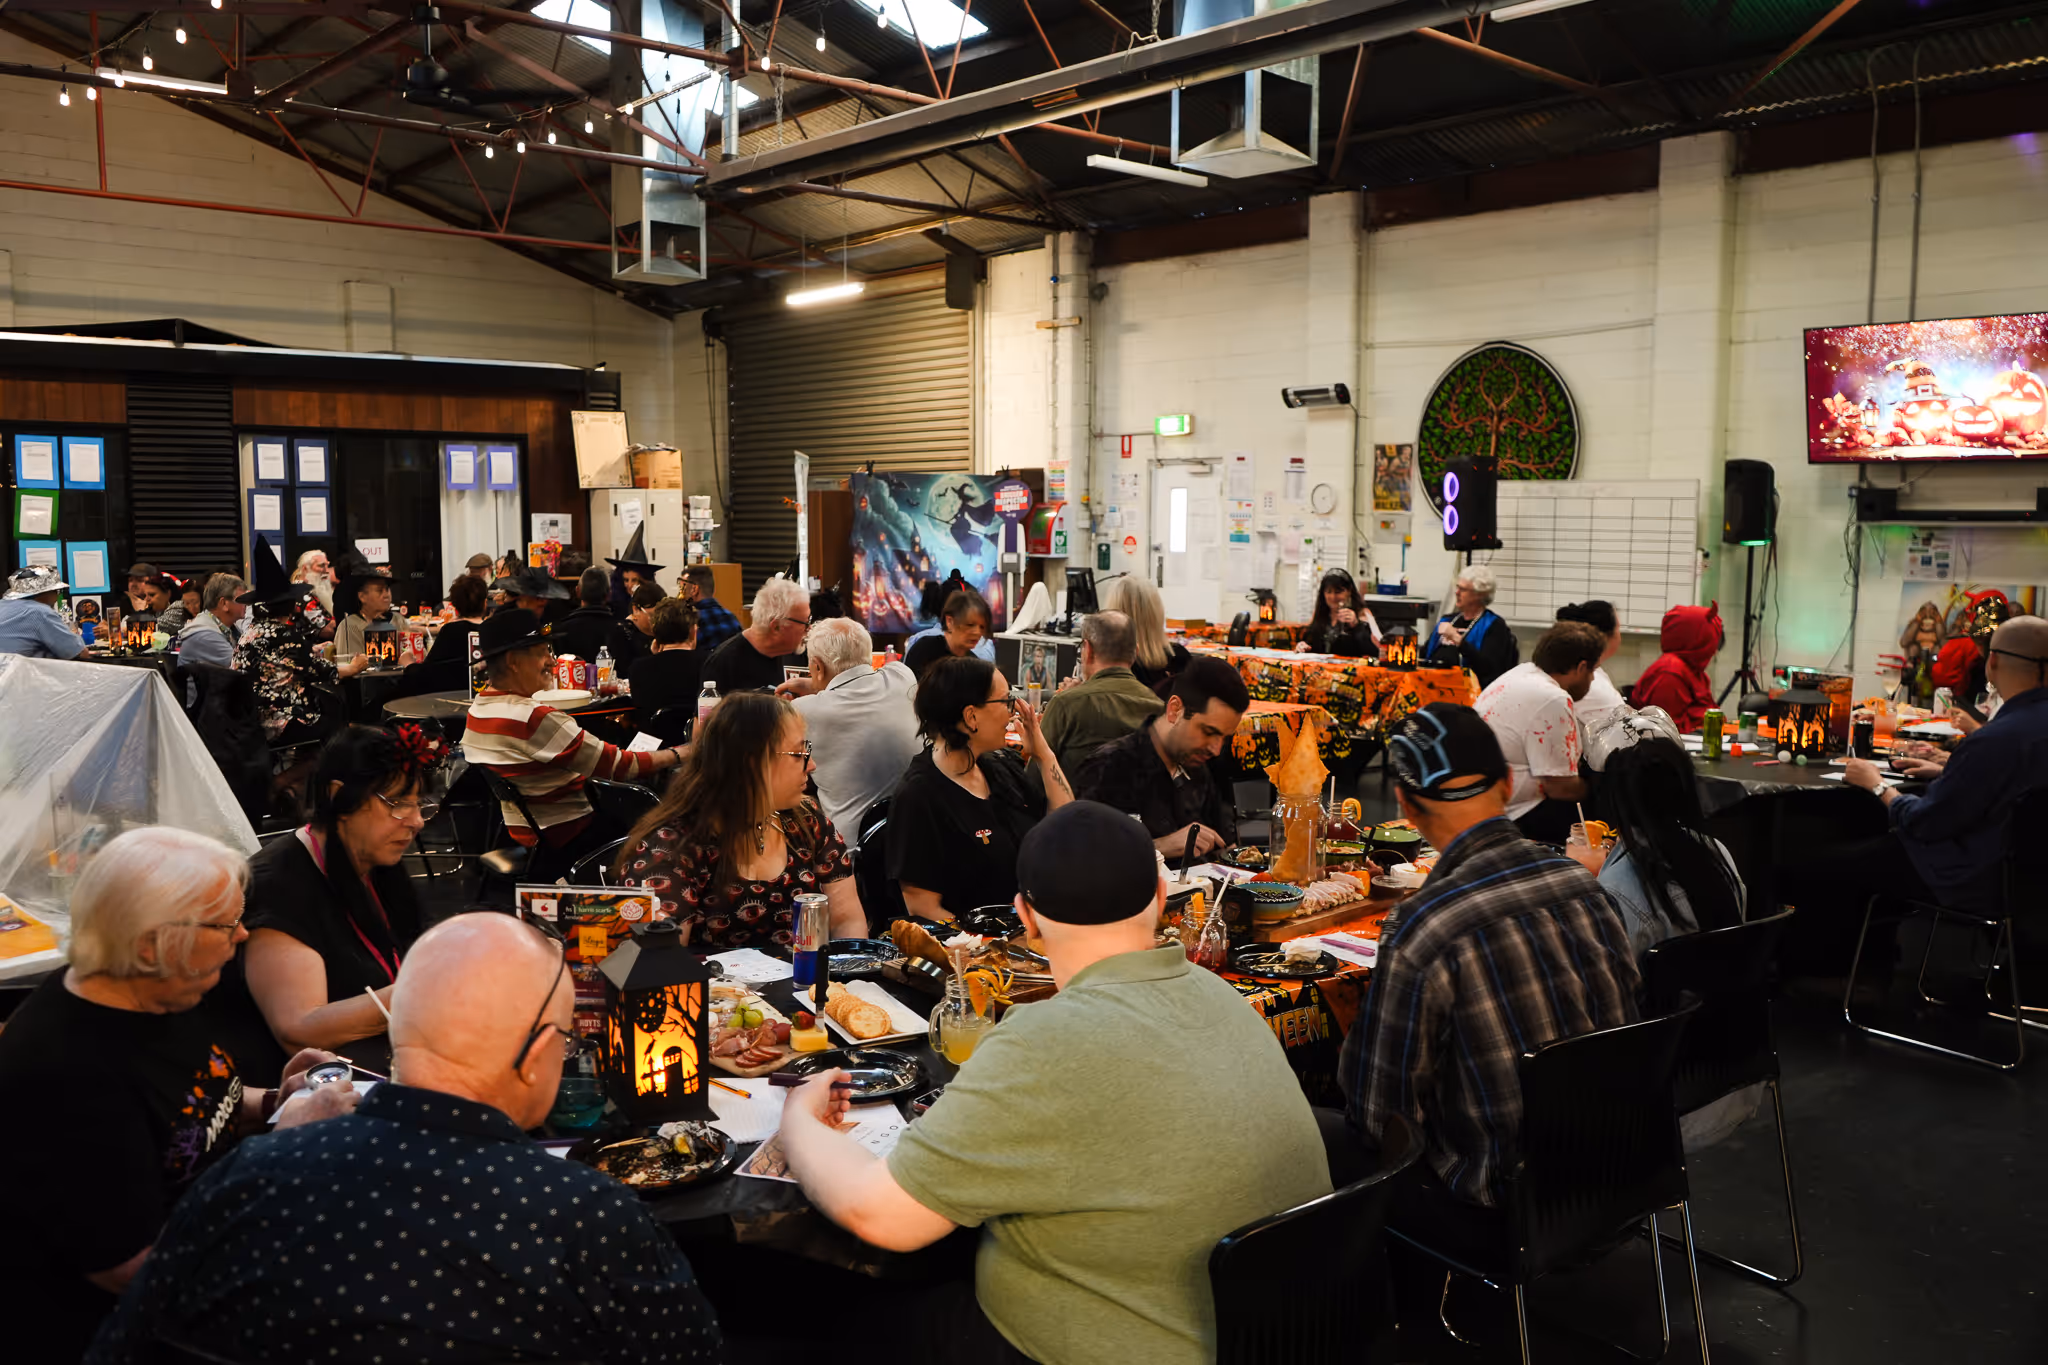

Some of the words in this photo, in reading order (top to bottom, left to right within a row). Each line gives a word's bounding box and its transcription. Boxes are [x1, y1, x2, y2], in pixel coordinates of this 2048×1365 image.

[363, 547, 381, 555] OUT
[795, 935, 812, 946] Bull
[579, 1019, 601, 1028] HOYTS
[664, 1053, 681, 1067] RIP
